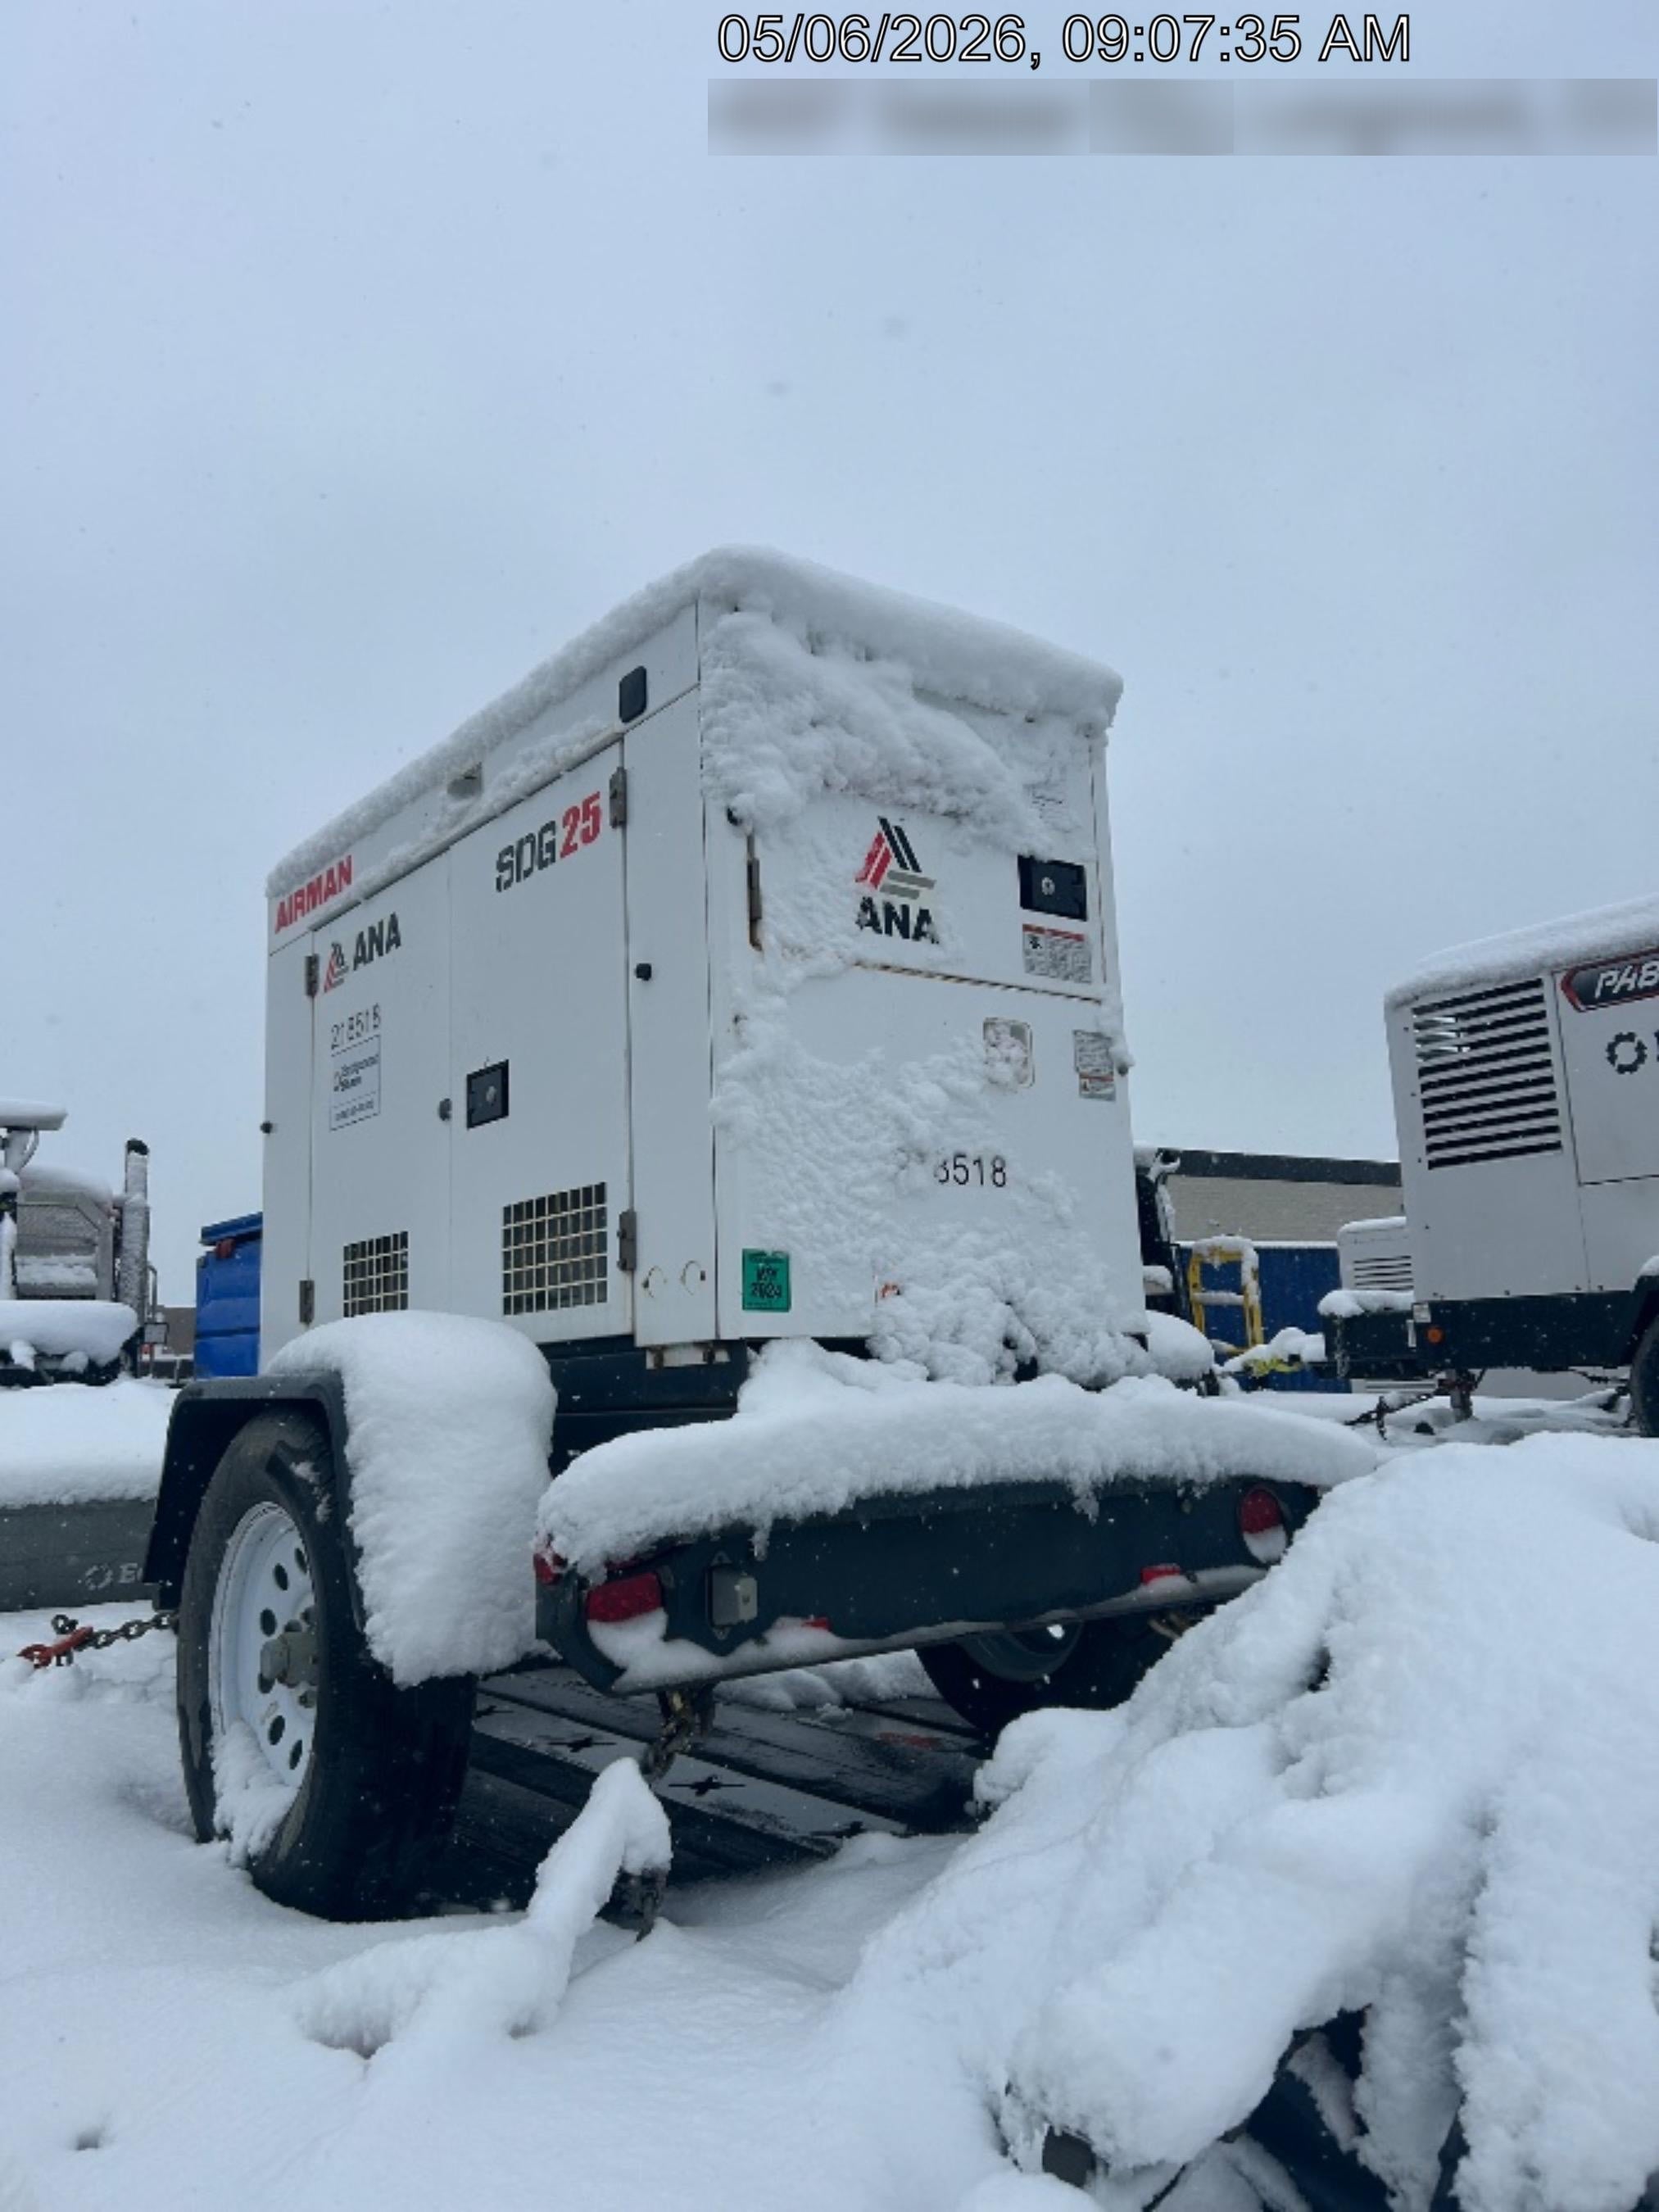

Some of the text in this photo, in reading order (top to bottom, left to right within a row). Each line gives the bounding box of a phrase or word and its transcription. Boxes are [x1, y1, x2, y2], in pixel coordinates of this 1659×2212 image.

[274, 854, 352, 935] AIRMAN
[854, 895, 940, 945] ANA
[353, 911, 401, 972] ANA
